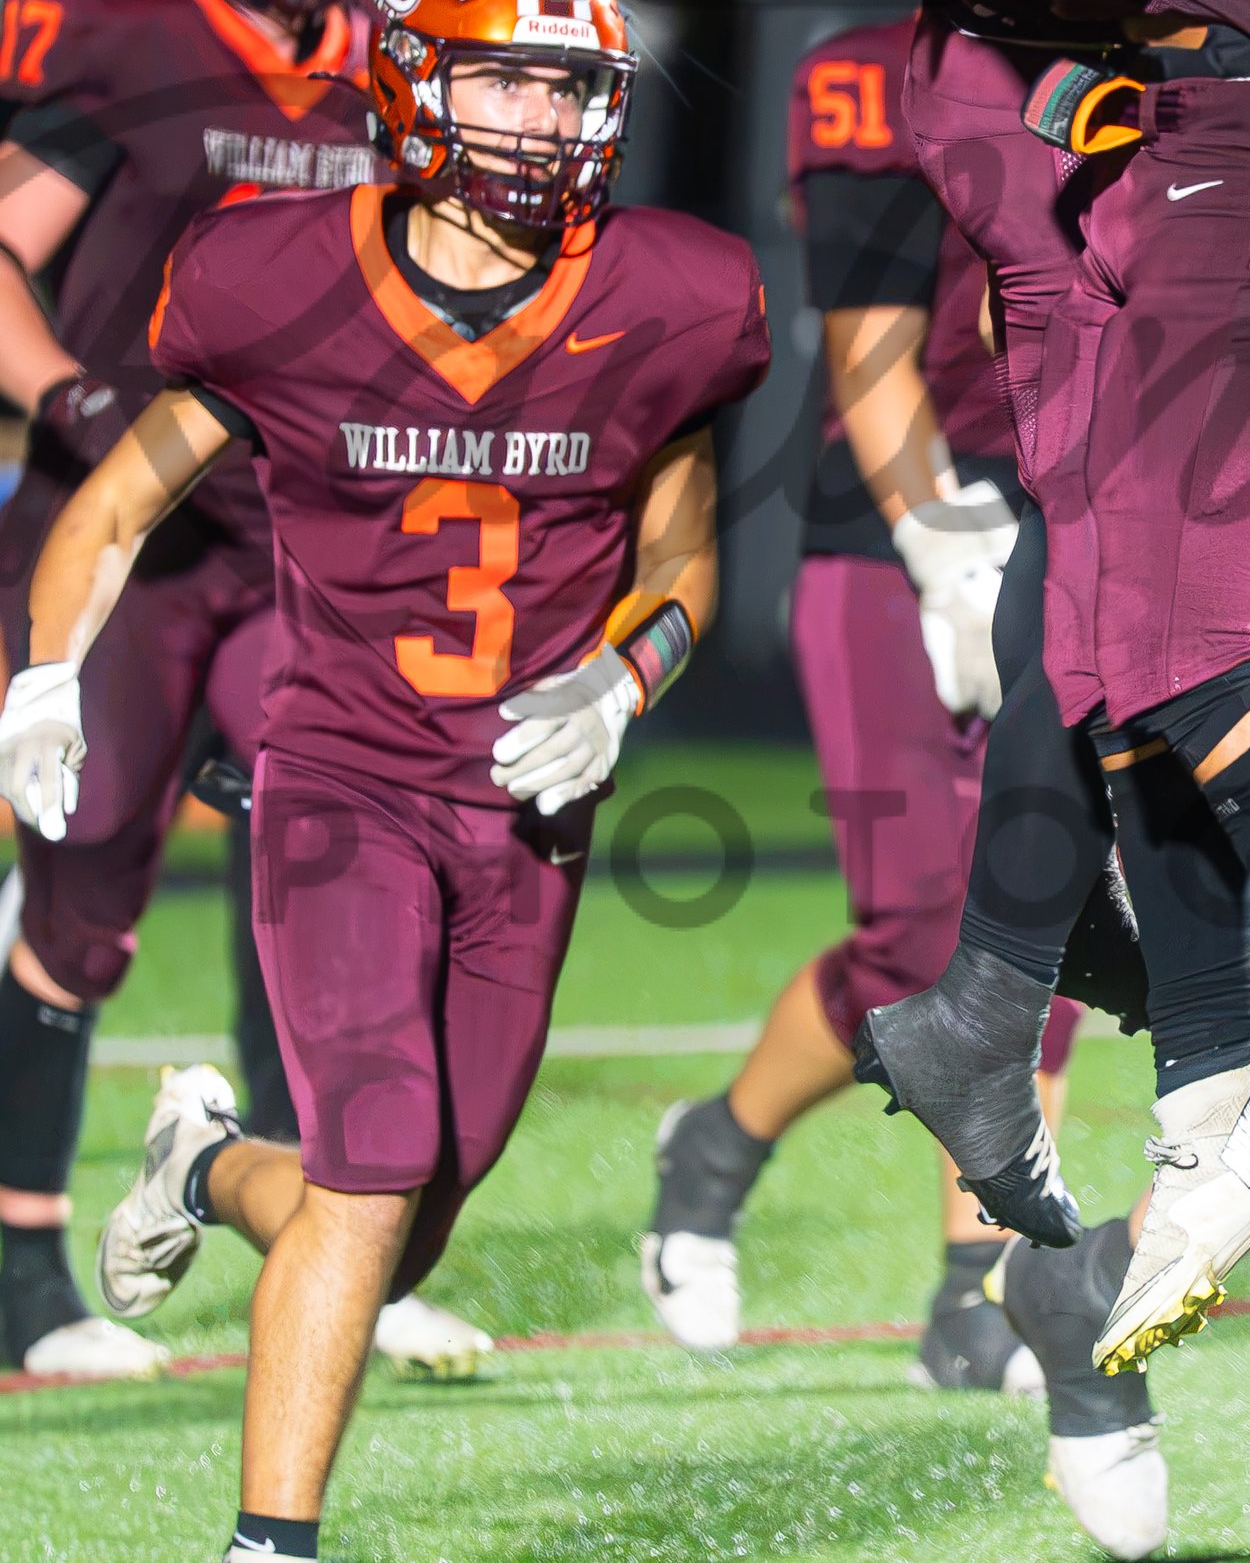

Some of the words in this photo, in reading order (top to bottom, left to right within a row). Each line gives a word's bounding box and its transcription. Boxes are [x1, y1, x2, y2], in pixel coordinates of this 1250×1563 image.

[528, 19, 591, 38] Riddell
[808, 60, 894, 148] 51
[339, 422, 495, 475] WILLIAM
[502, 431, 591, 476] BYRD
[394, 476, 521, 698] 3
